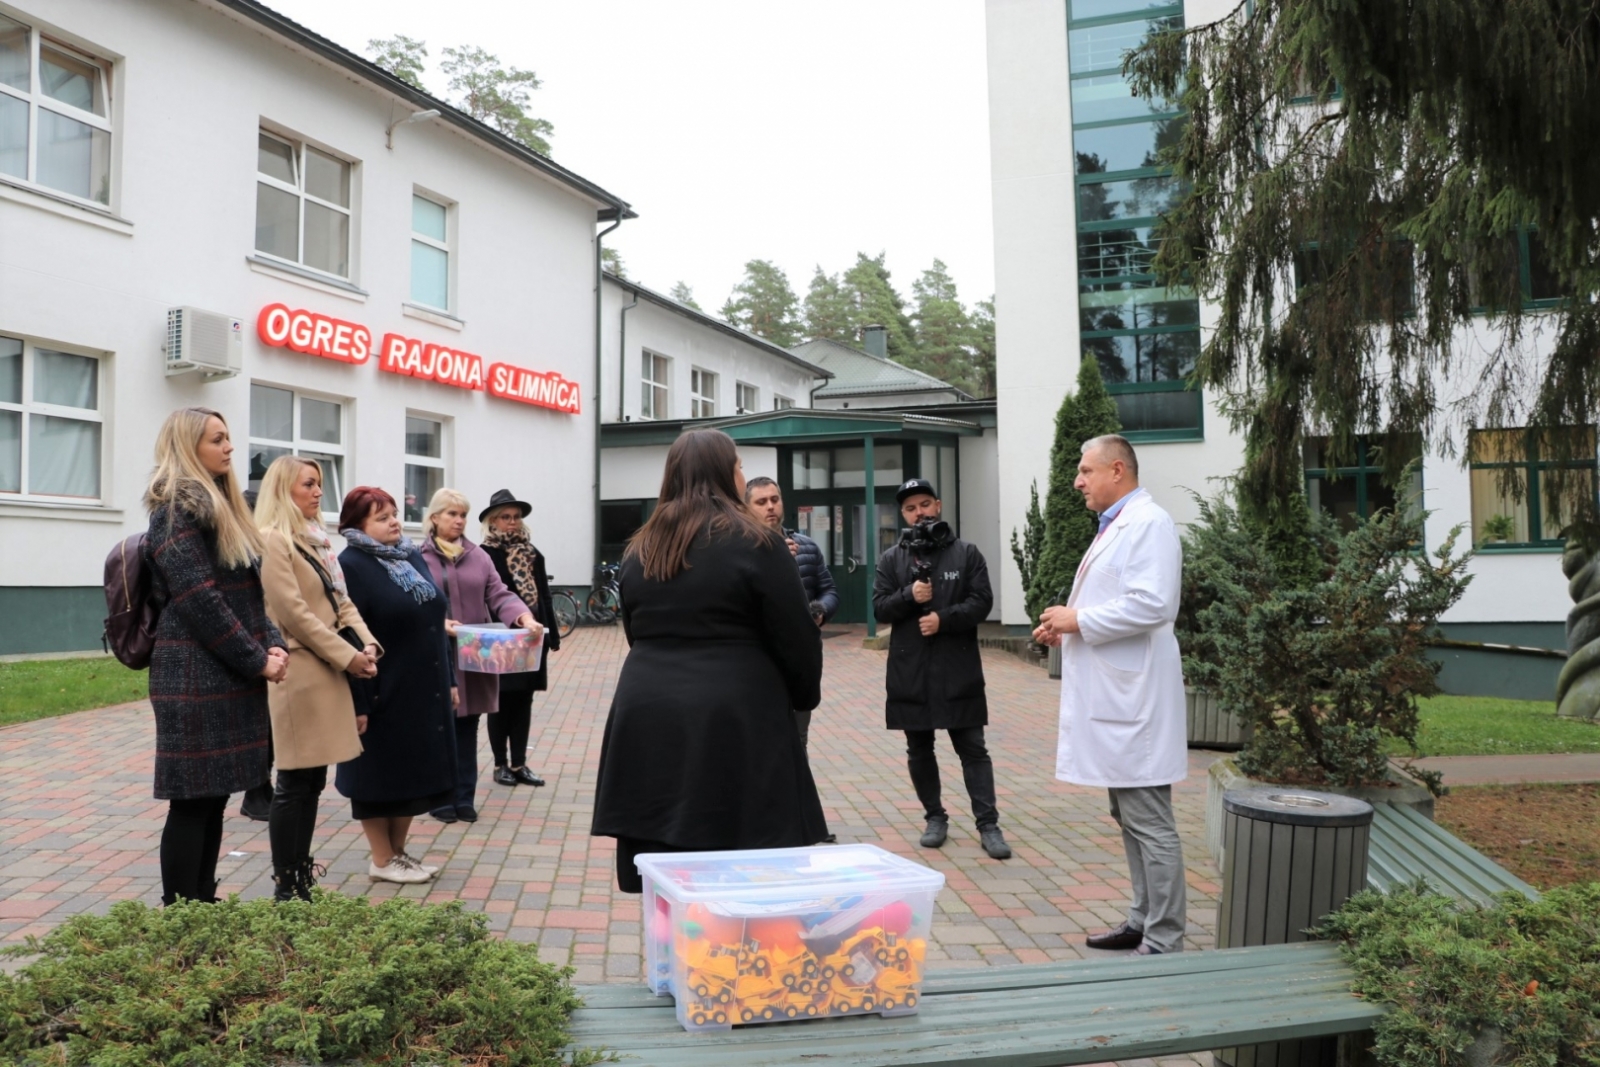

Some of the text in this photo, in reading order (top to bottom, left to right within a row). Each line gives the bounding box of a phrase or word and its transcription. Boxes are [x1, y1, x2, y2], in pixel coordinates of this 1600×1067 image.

[265, 307, 579, 411] OGRES RAJONA SLIMNĪCA
